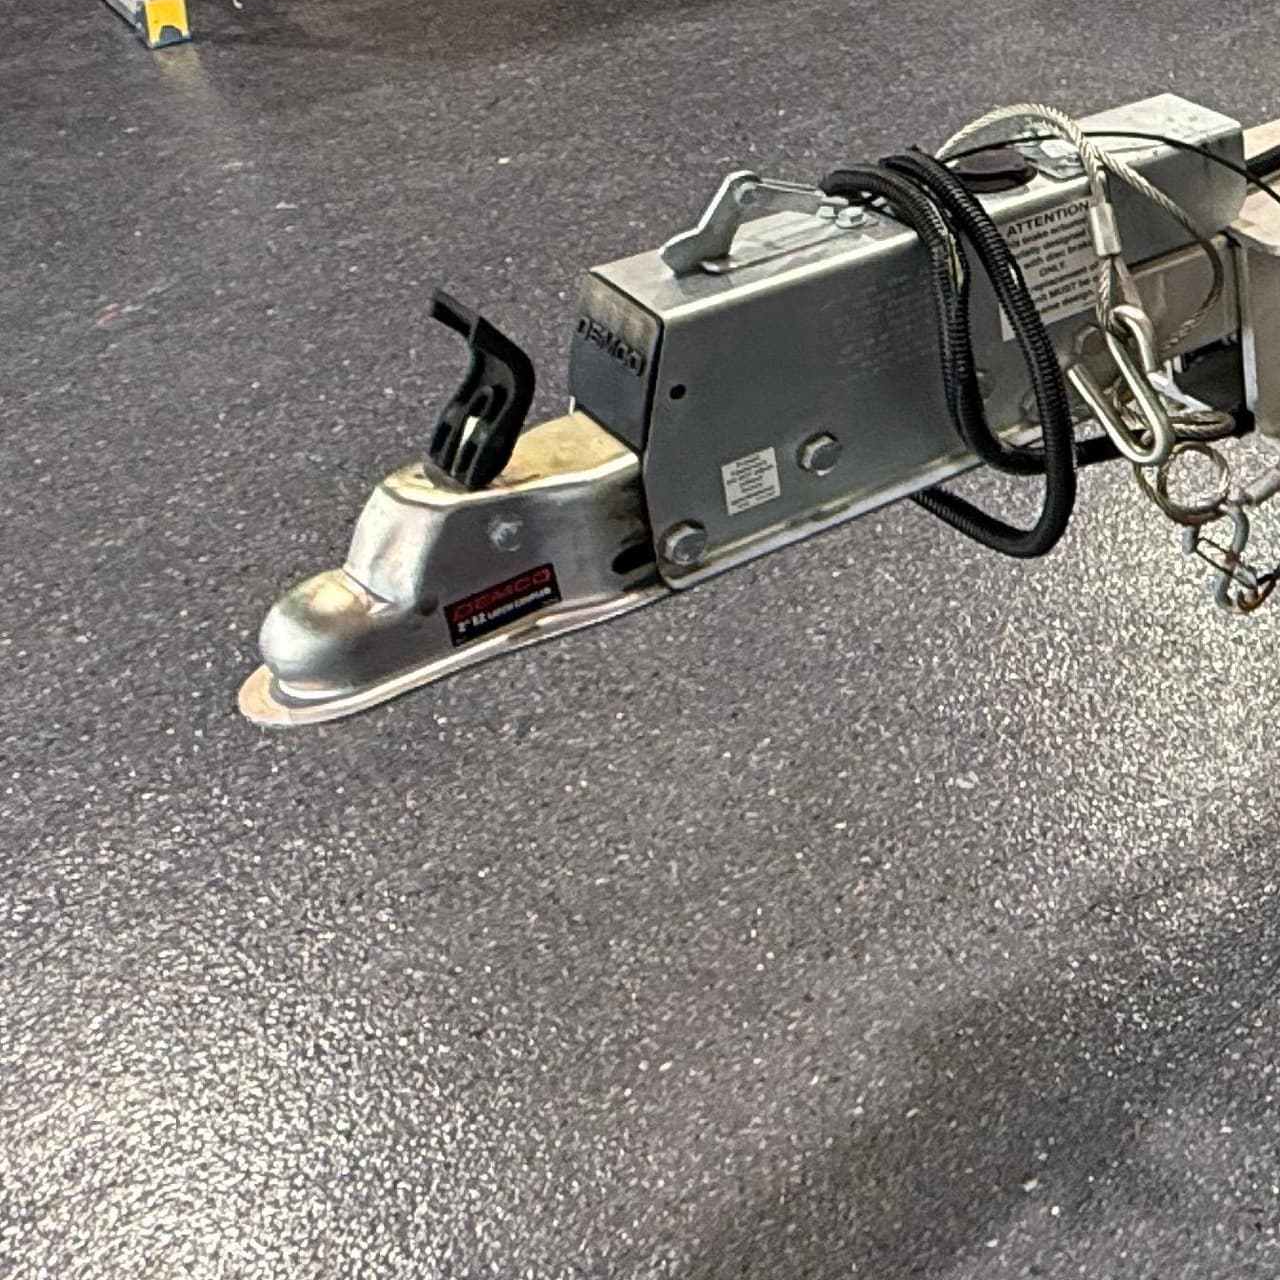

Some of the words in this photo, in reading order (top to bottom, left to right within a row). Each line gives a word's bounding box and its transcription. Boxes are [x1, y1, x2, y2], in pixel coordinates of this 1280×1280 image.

[1007, 199, 1090, 238] ATTENTION
[576, 315, 647, 376] DEMCO
[453, 568, 551, 623] DEMCO
